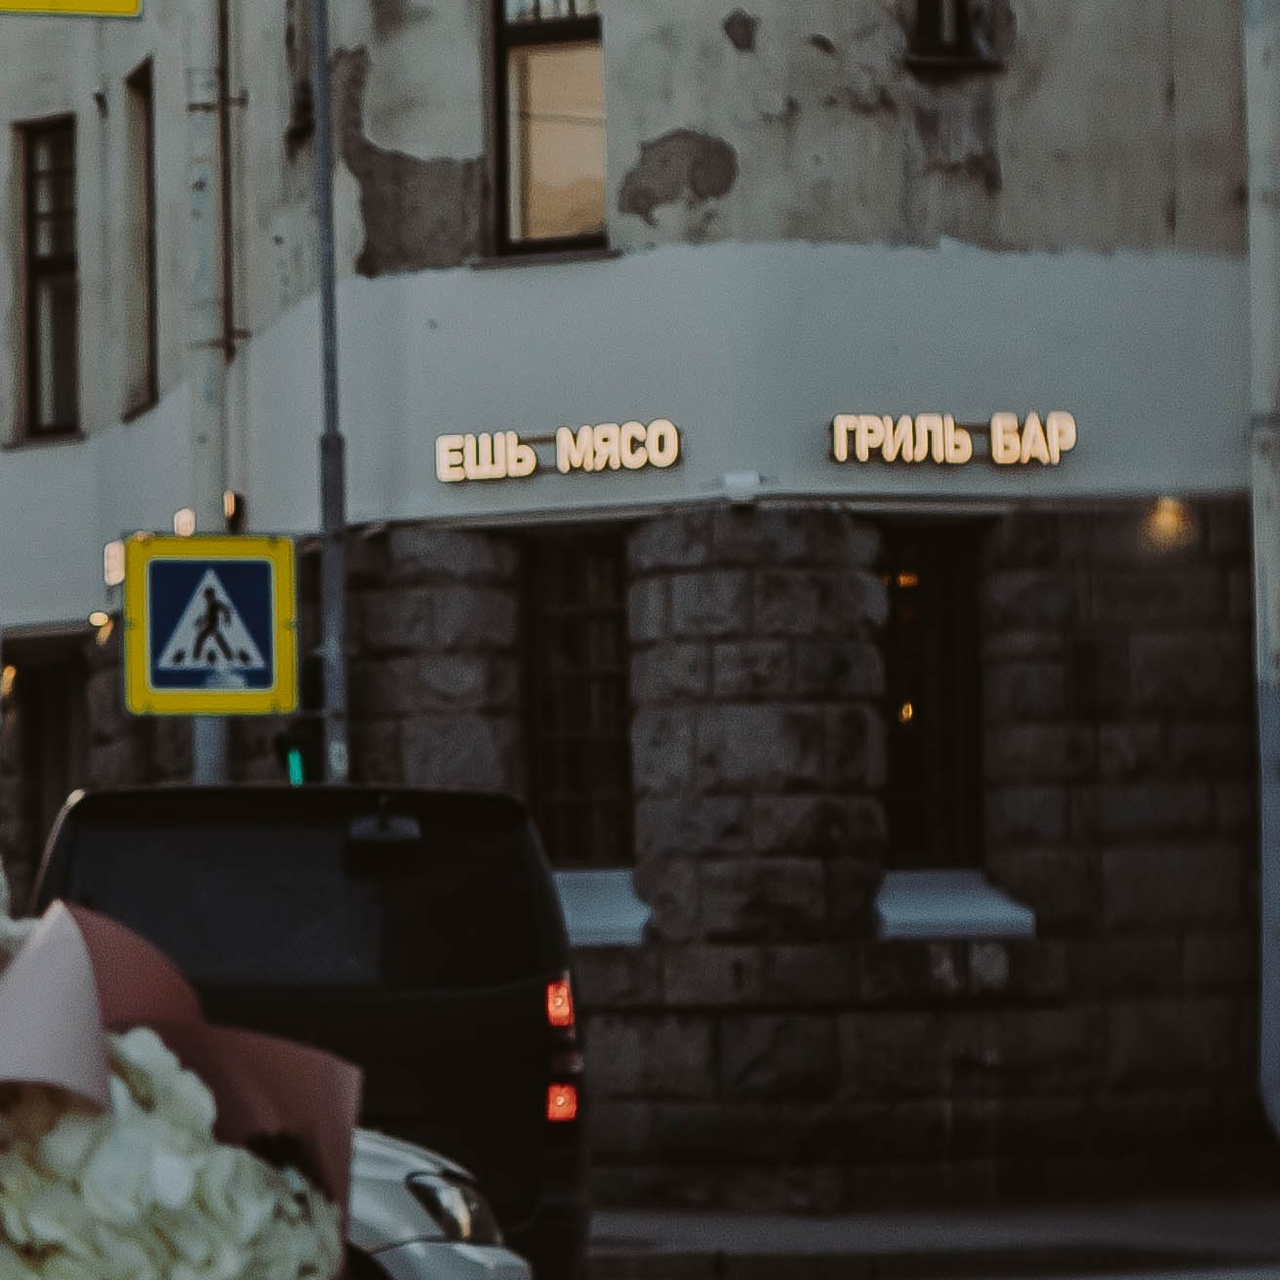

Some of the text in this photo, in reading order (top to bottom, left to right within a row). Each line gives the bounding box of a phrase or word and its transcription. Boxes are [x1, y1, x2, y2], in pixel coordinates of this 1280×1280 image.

[435, 419, 679, 482] ЕШЬ МЯСО
[833, 410, 1077, 466] ГРИЛЬ БАР
